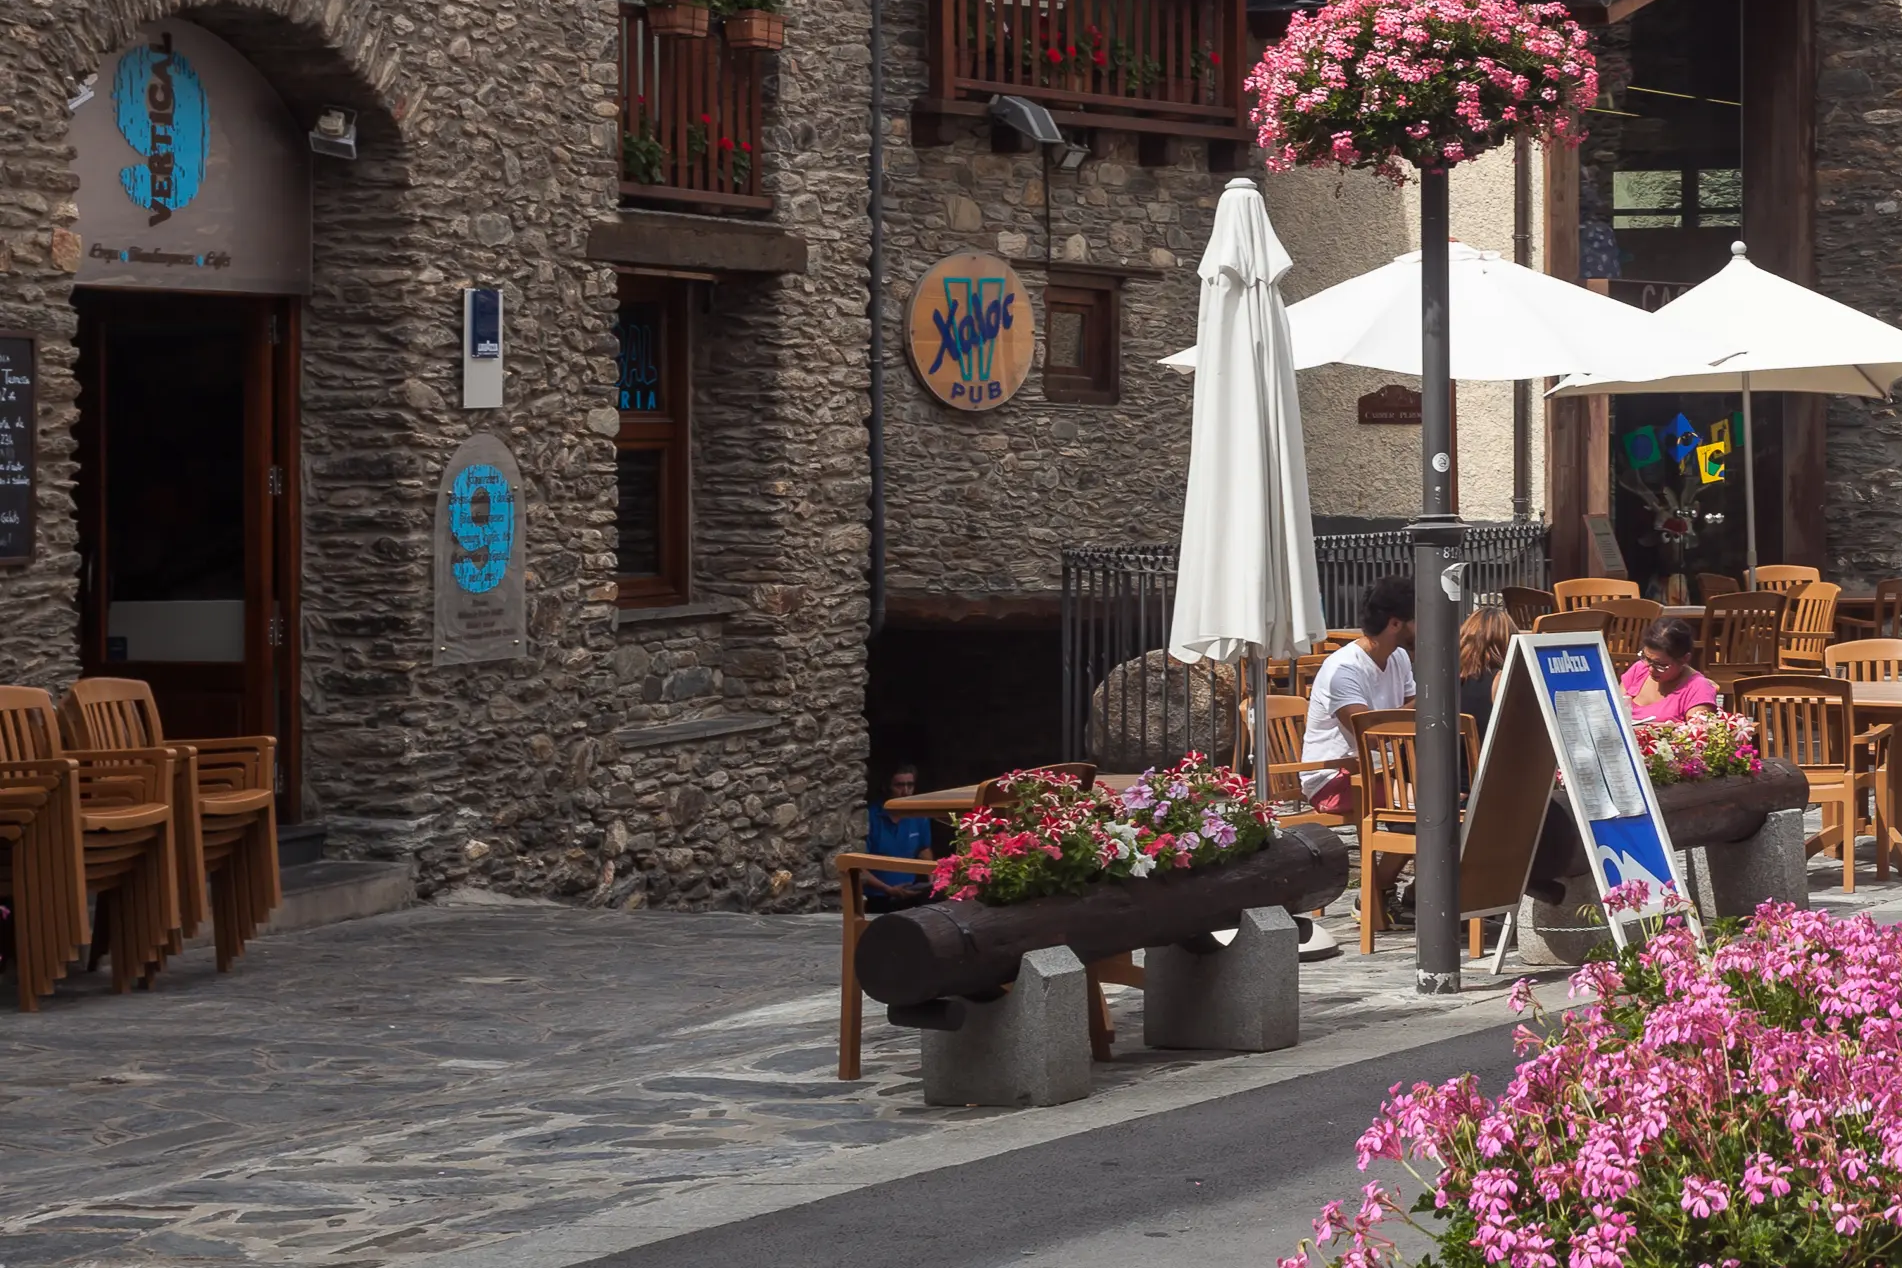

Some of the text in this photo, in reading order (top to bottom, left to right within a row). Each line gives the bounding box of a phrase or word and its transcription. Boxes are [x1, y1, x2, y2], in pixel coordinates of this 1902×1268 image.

[148, 32, 175, 227] VERTICAL
[1641, 284, 1687, 313] CA
[928, 293, 1015, 375] Xaloc
[951, 381, 1003, 403] PUB
[1547, 650, 1591, 674] LAVAZZA
